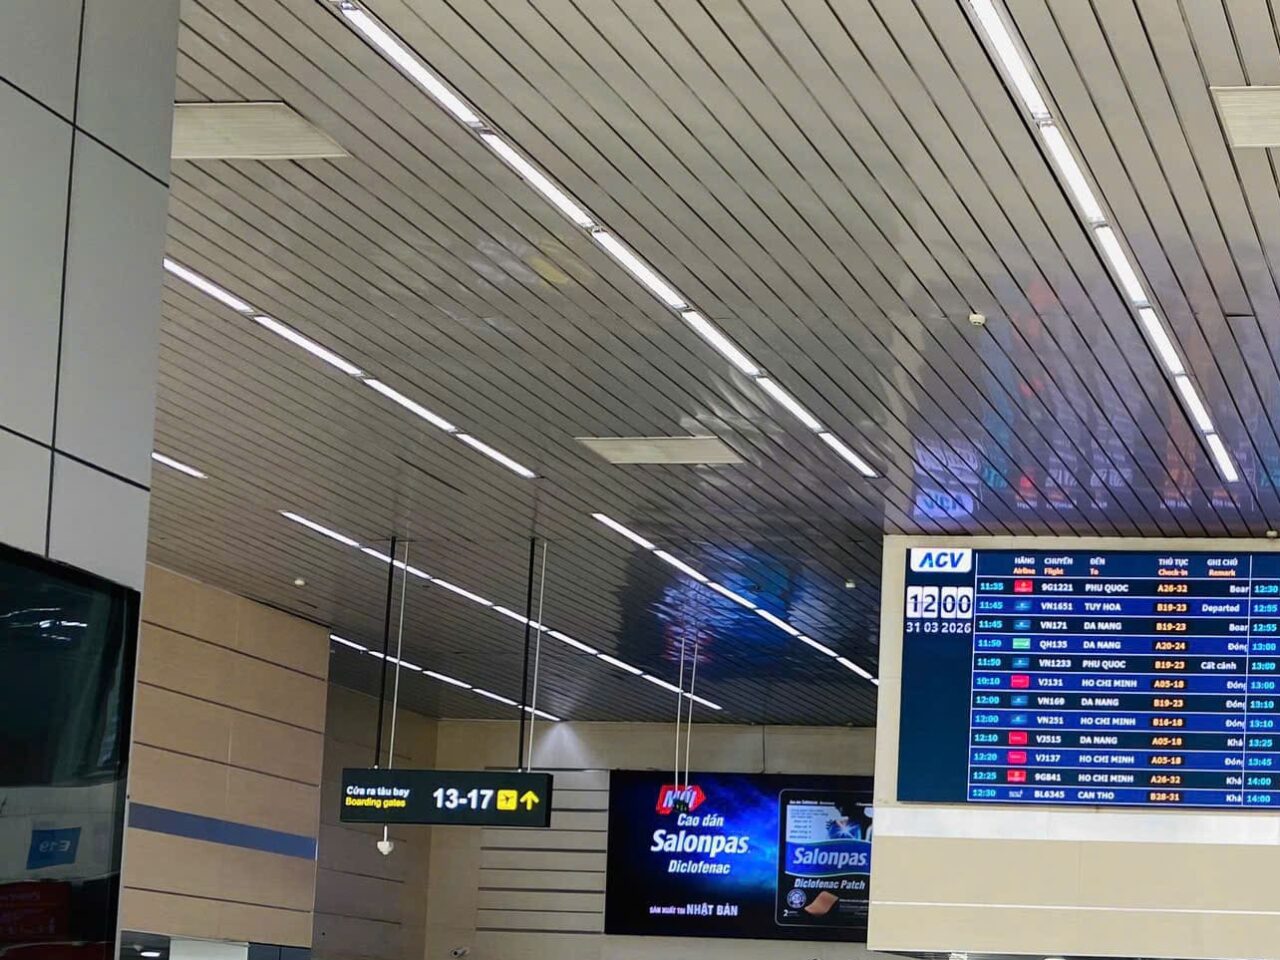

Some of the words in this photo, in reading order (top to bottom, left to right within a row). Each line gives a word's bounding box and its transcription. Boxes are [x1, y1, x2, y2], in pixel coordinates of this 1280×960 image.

[918, 552, 965, 568] ACV
[1084, 583, 1106, 593] PHU
[1106, 583, 1129, 594] QUOC
[910, 594, 936, 613] 12
[942, 594, 971, 613] 00
[1084, 602, 1102, 612] TUY
[1102, 602, 1122, 612] HOA
[1201, 604, 1241, 614] Departed
[906, 622, 920, 632] 31
[923, 622, 939, 633] 03
[941, 622, 972, 633] 2026
[1083, 621, 1097, 631] DA
[1097, 621, 1123, 631] NANG
[1082, 659, 1101, 669] PHU
[1101, 659, 1127, 671] QUOC
[1081, 678, 1096, 688] HO
[1096, 678, 1113, 688] CHI
[1113, 678, 1138, 689] MINH
[1079, 735, 1093, 745] DA
[1093, 735, 1118, 745] NANG
[367, 788, 377, 796] ra
[379, 786, 392, 796] tàu
[393, 788, 410, 798] bay
[433, 787, 494, 809] 13-17
[1077, 790, 1096, 800] CAN
[1096, 790, 1115, 801] THO
[345, 797, 382, 808] Boarding
[383, 799, 406, 809] gates
[677, 813, 699, 827] Cao
[702, 813, 724, 827] dán
[650, 829, 750, 858] Salonpas
[793, 847, 868, 869] Salonpas
[668, 859, 731, 874] Diclofenac
[794, 878, 839, 889] Diclofenac
[840, 879, 865, 890] Patch
[686, 902, 714, 916] NHẬT
[716, 903, 738, 916] BẢN
